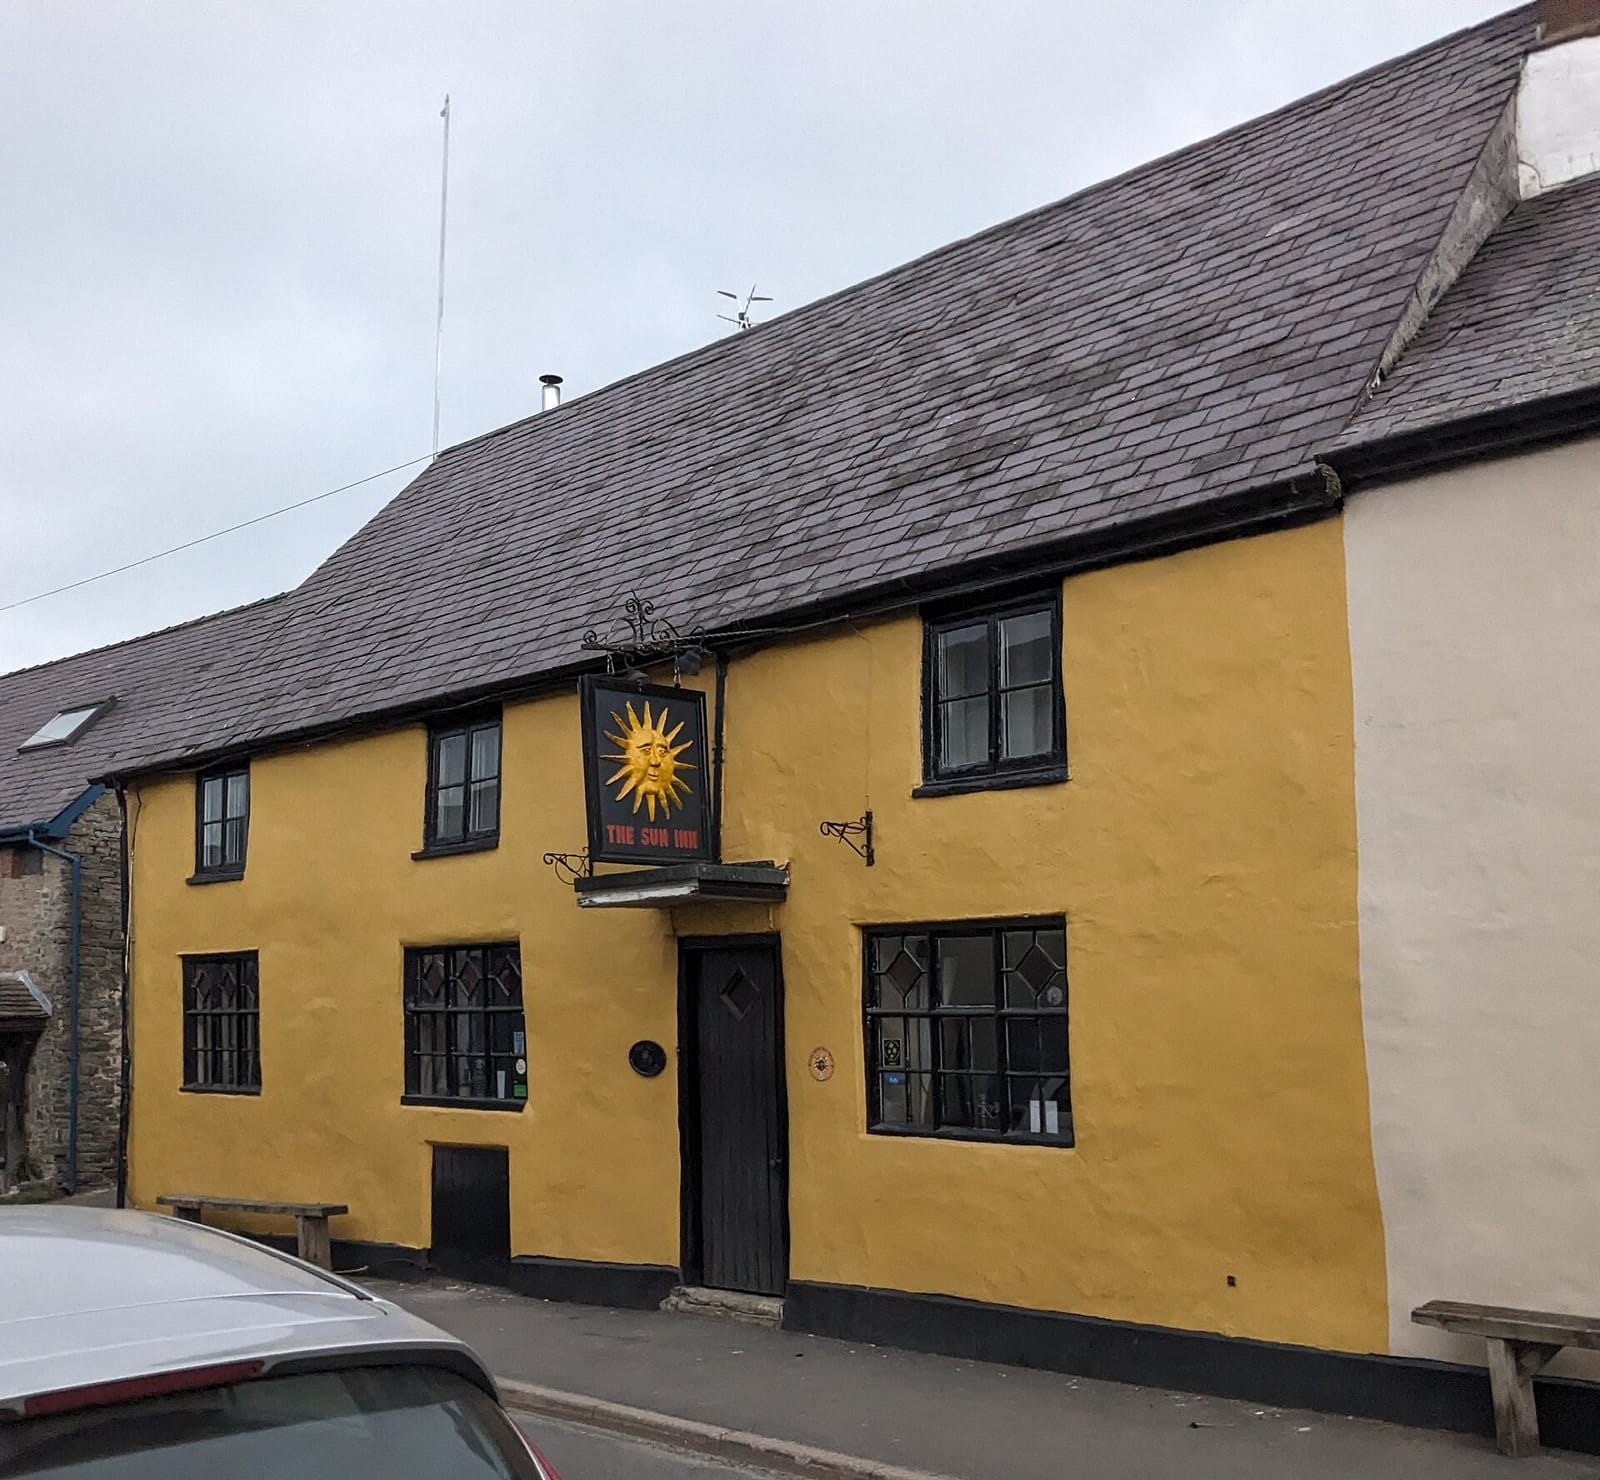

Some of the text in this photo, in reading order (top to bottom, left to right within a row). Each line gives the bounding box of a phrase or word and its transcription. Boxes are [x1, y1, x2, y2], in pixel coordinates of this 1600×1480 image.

[606, 824, 698, 849] THE SUN INN
